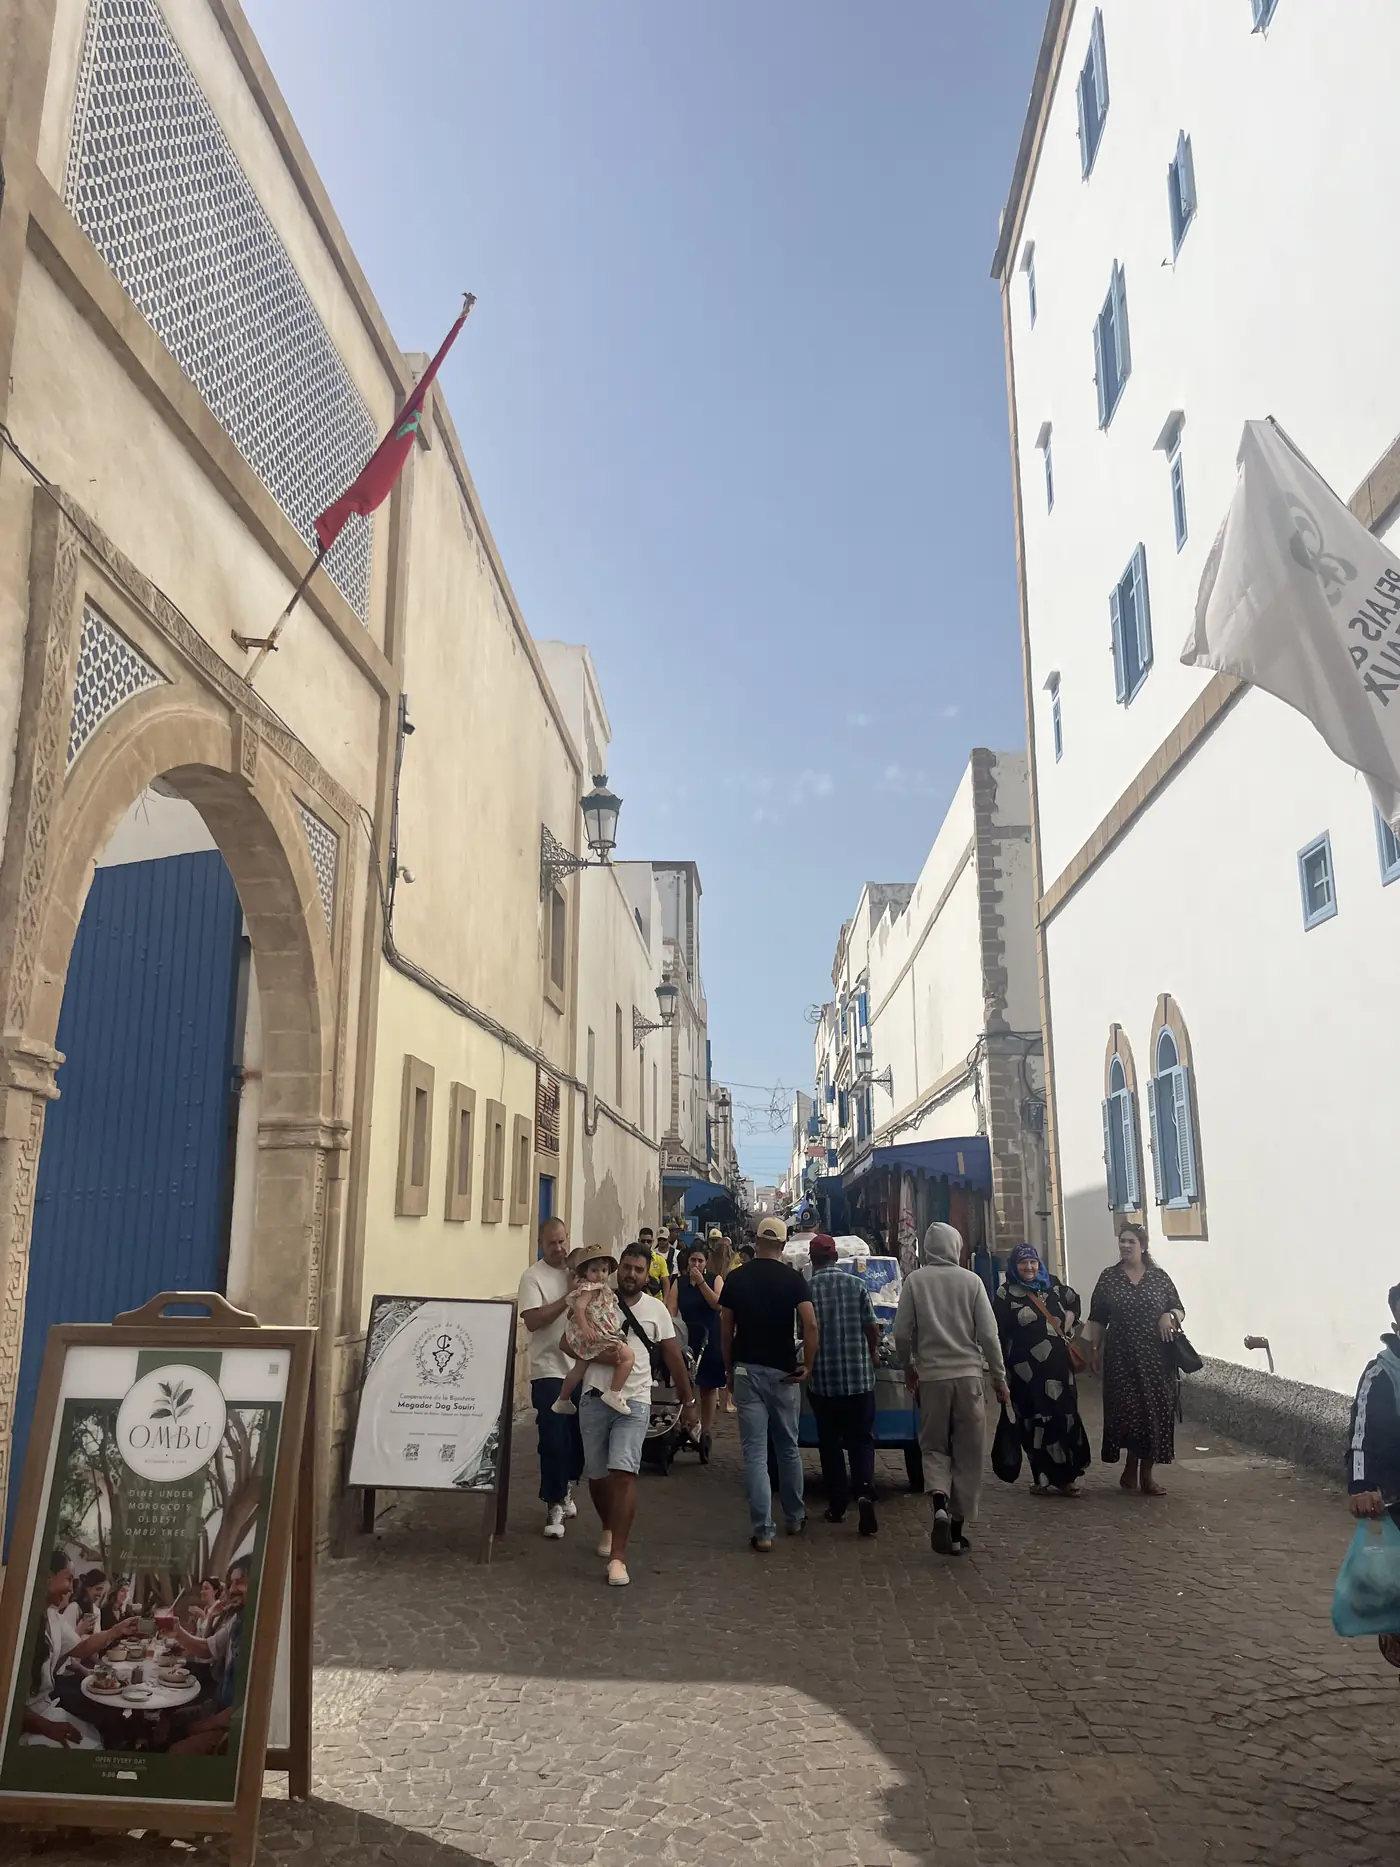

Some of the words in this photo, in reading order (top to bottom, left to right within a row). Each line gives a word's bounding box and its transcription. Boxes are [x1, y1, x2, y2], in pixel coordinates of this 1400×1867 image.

[866, 1270, 887, 1279] Selpak
[398, 1401, 433, 1410] Mogador
[453, 1403, 475, 1411] Souiri
[129, 1489, 154, 1498] DINE
[159, 1490, 194, 1499] UNDER
[128, 1502, 191, 1511] MOROCCO'S
[138, 1515, 177, 1524] OLDEST
[161, 1529, 187, 1537] TREE
[112, 1756, 132, 1764] EVERY
